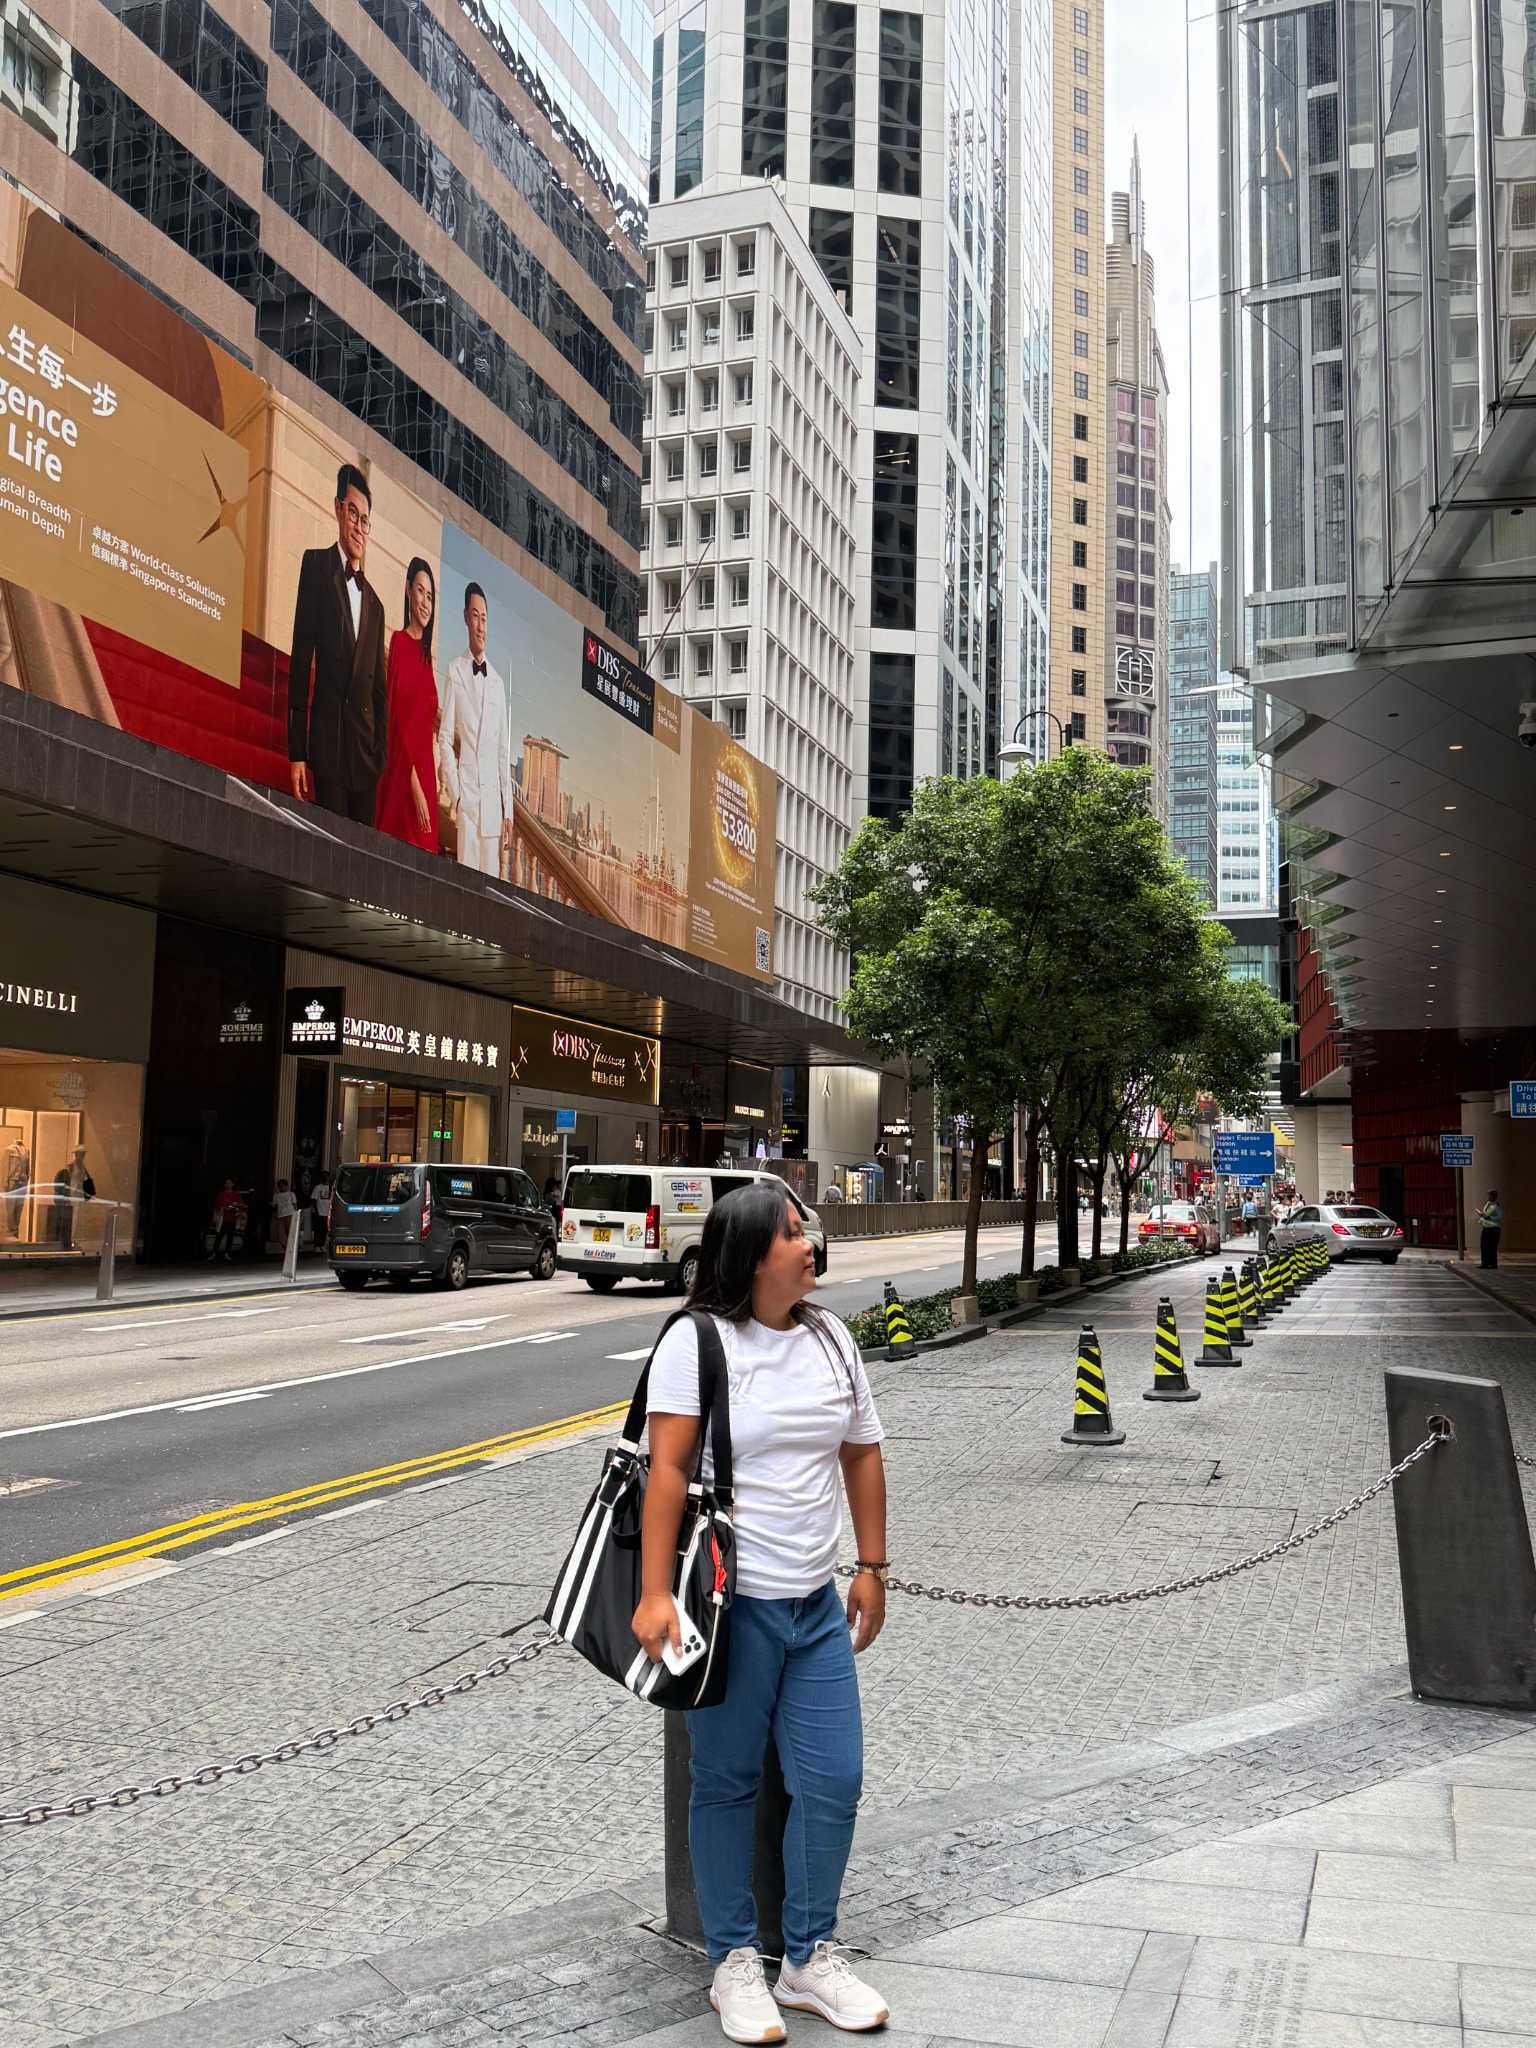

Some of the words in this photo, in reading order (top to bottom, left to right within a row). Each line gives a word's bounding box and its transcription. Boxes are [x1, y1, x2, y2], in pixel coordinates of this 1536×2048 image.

[0, 324, 117, 416] 生每一步
[8, 422, 62, 482] Life
[0, 477, 25, 499] gital
[28, 490, 71, 523] Breadth
[32, 511, 65, 539] Depth
[92, 525, 130, 555] 卓越方案
[130, 545, 184, 584] World-Class
[186, 576, 226, 606] Solutions
[130, 563, 176, 596] Singapore
[177, 589, 222, 620] Standards
[597, 645, 620, 679] DBS
[620, 666, 652, 705] Treasures
[597, 674, 640, 717] 星展豐盛理財
[721, 810, 757, 855] 53,800
[292, 1022, 336, 1031] EMPEROR
[343, 1016, 404, 1044] EMPEROR
[565, 1033, 590, 1060] DBS
[433, 1131, 452, 1139] ROEX
[1235, 2013, 1256, 2048] OBSTRUC
